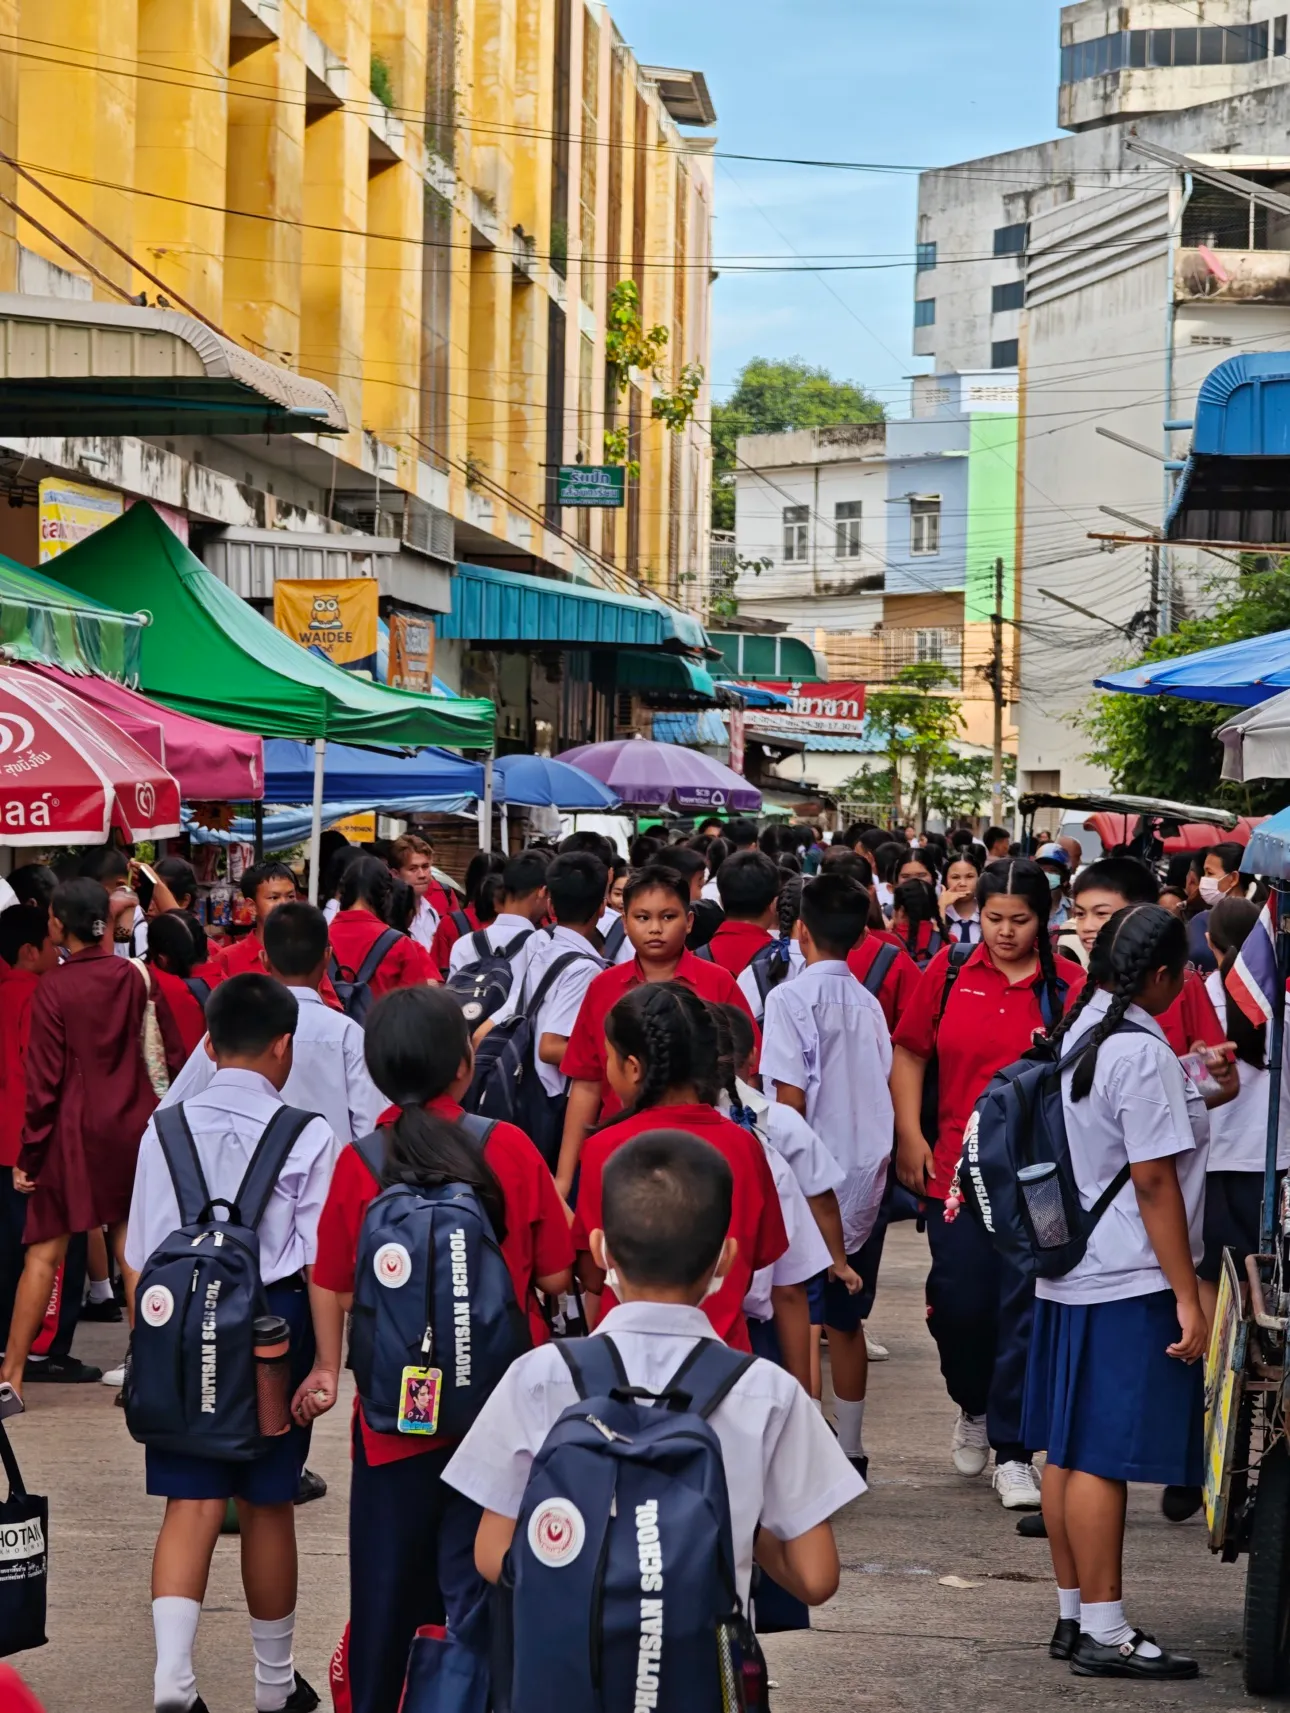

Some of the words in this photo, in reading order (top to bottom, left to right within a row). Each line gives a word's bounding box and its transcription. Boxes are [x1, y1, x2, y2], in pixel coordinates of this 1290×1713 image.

[298, 631, 353, 643] WAIDEE
[970, 1166, 996, 1233] PHOTISAN
[449, 1228, 469, 1297] SCHOOL
[201, 1280, 221, 1340] SCHOOL
[453, 1302, 471, 1387] PHOTISAN
[201, 1344, 217, 1413] PHOTISAN
[635, 1499, 664, 1592] SCHOOL
